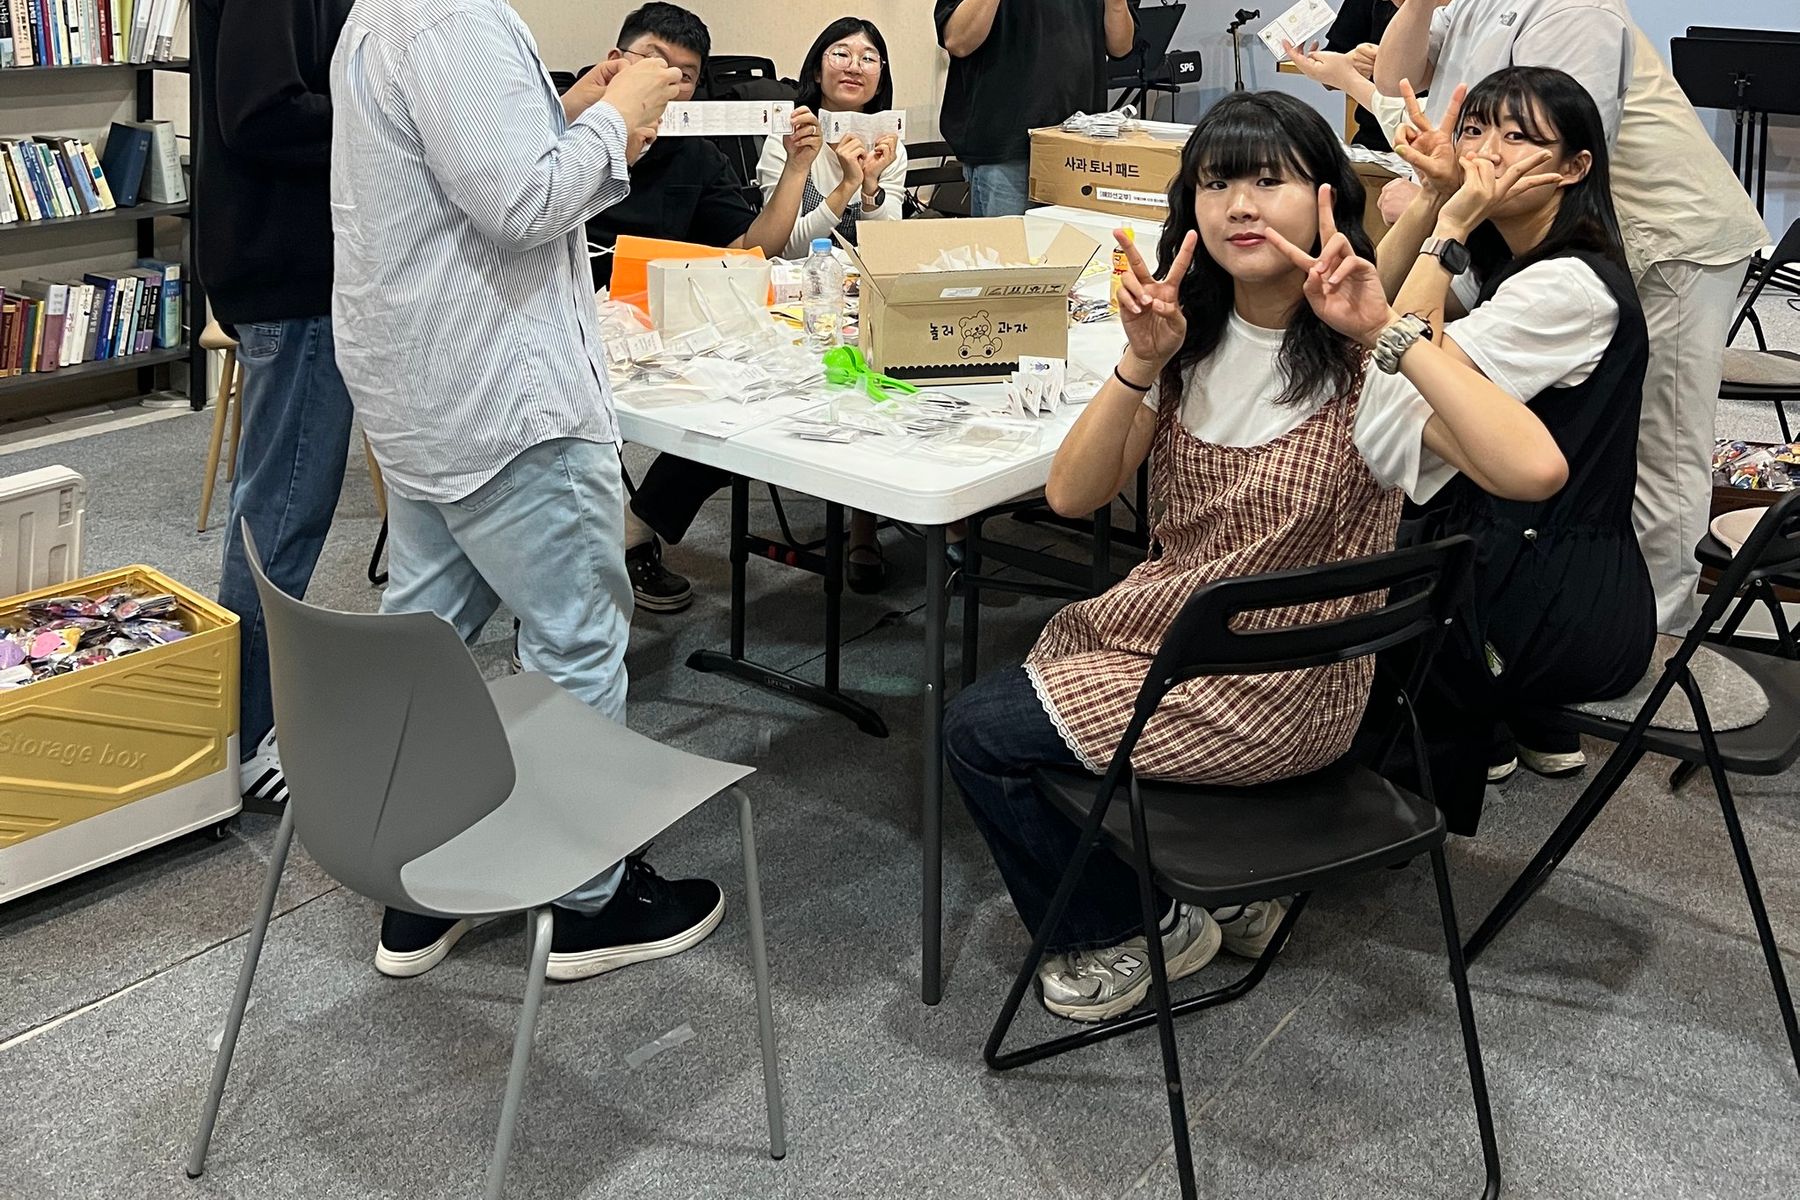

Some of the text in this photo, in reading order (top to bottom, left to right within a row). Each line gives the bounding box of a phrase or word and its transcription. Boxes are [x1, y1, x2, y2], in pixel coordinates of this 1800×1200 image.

[1179, 62, 1195, 73] SP6
[1064, 156, 1140, 178] 사과 토너 패드
[929, 321, 1029, 341] 놀러 과자
[0, 730, 149, 769] Storage box
